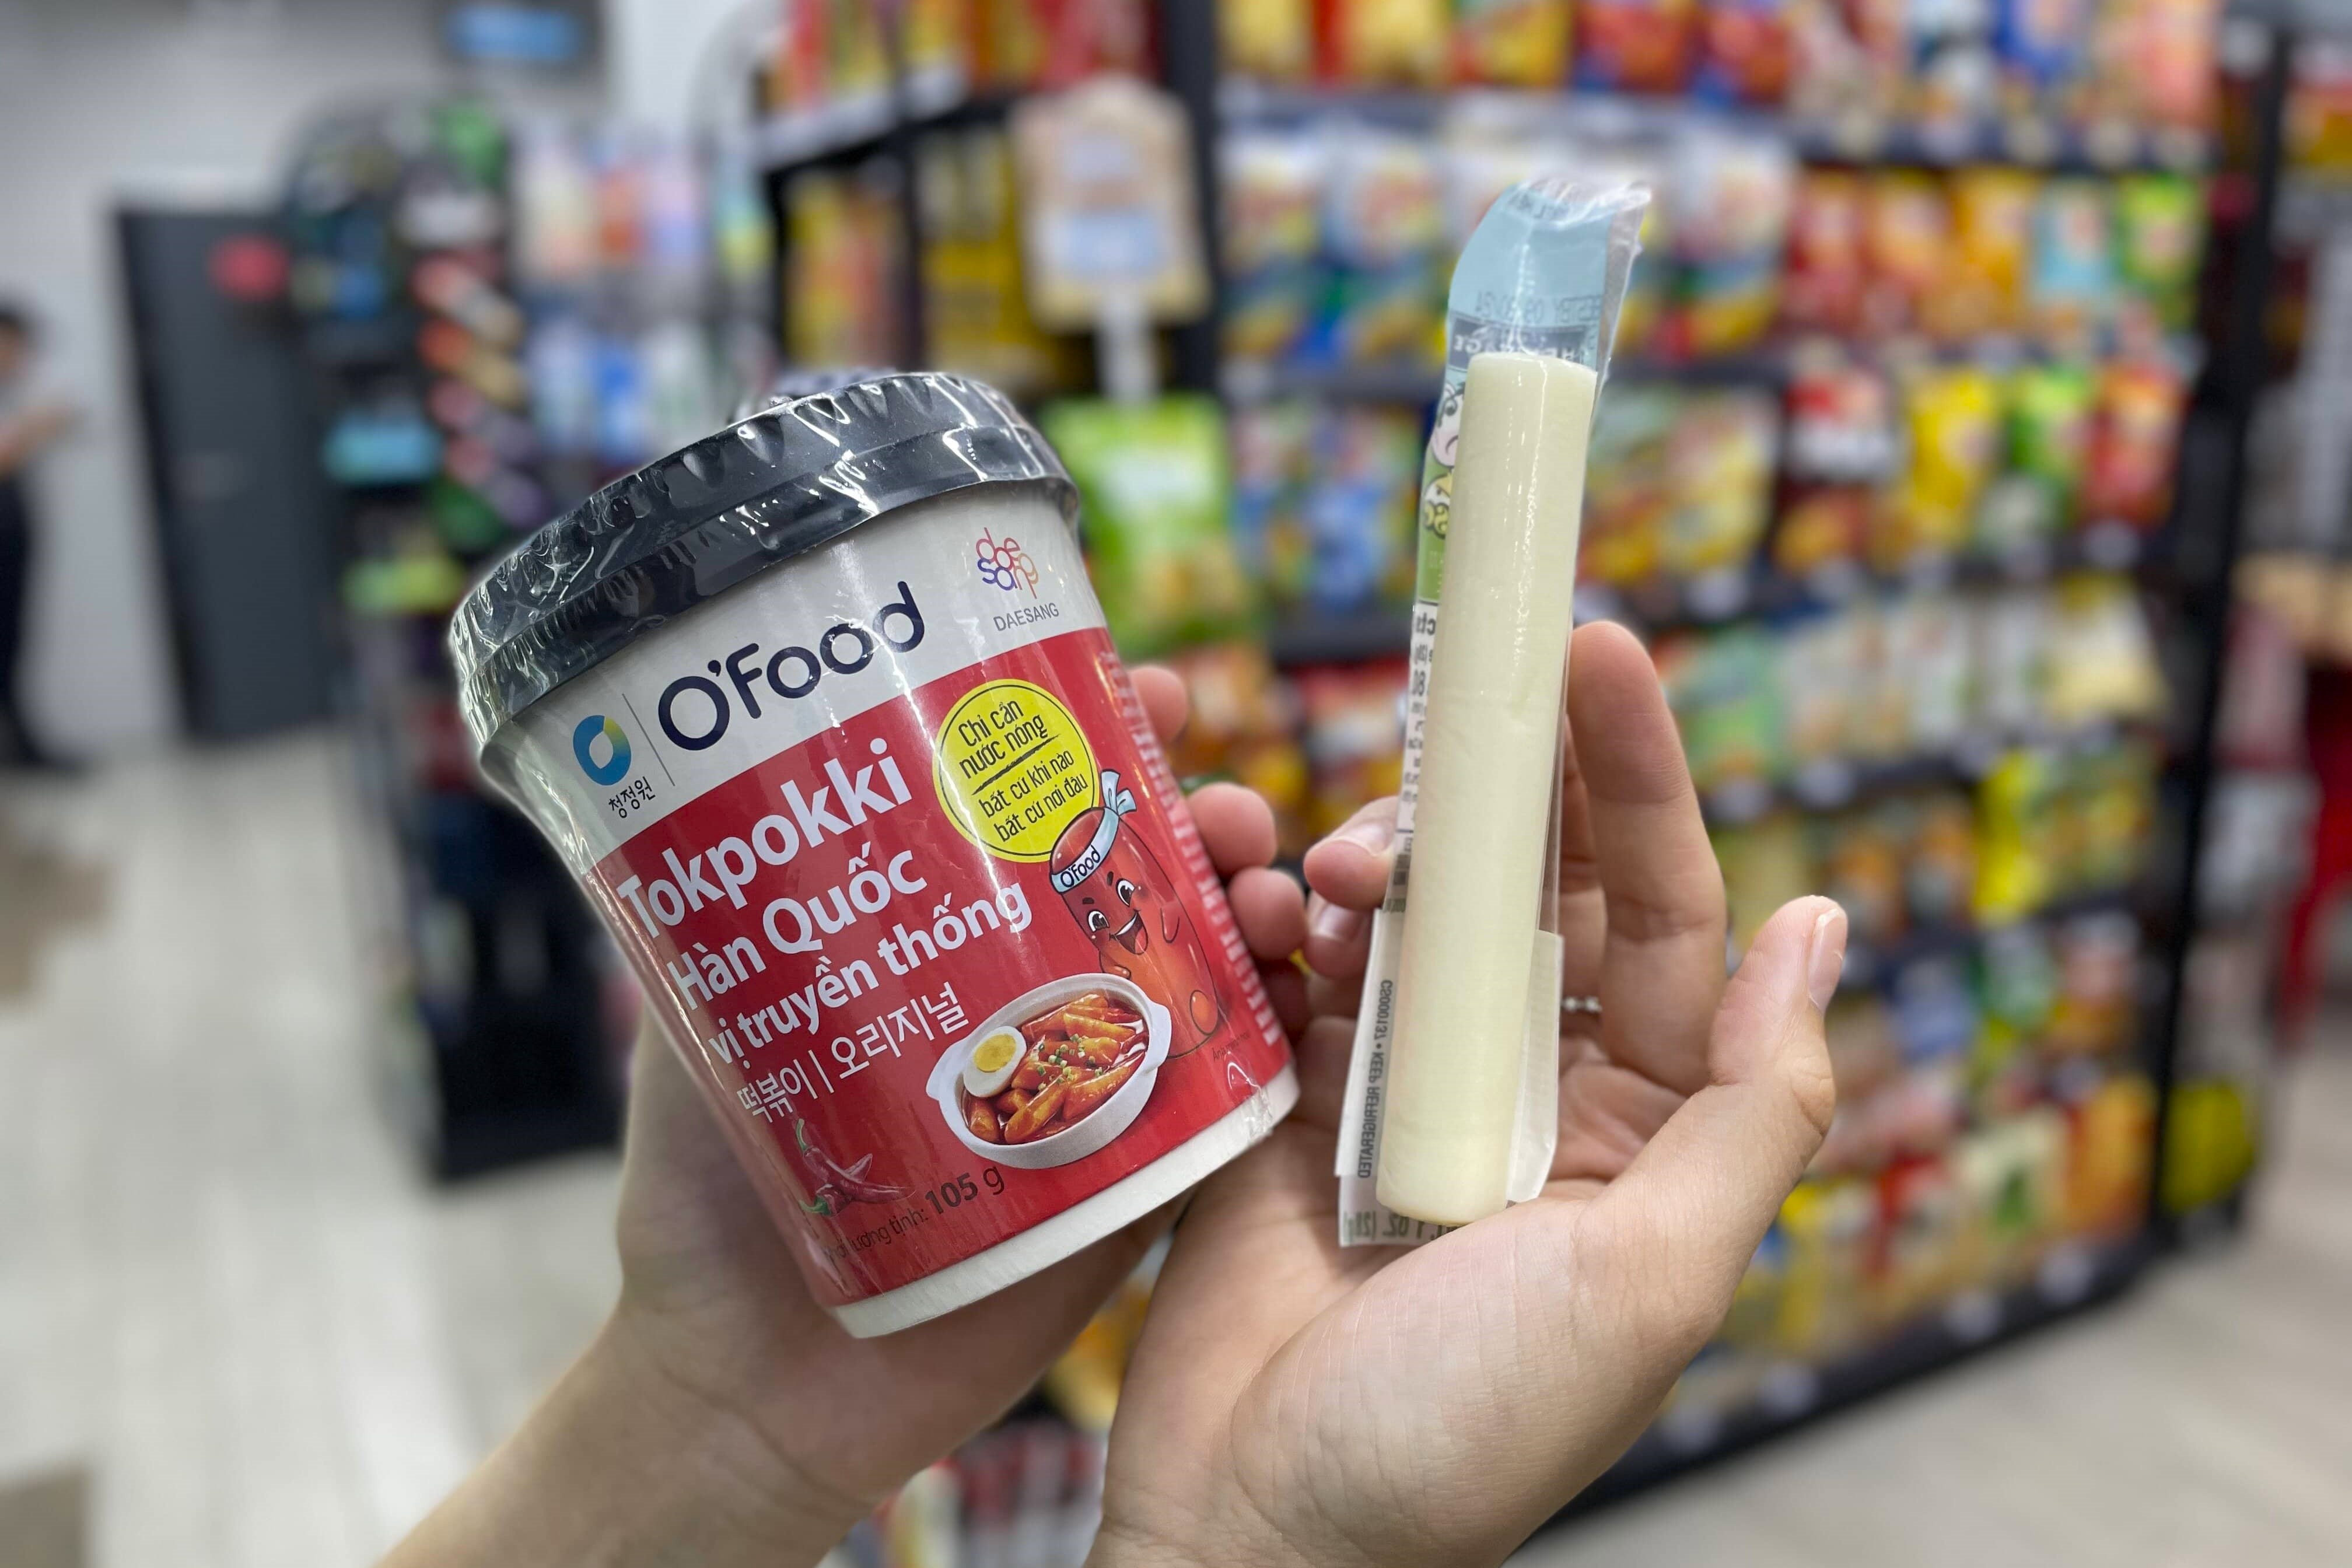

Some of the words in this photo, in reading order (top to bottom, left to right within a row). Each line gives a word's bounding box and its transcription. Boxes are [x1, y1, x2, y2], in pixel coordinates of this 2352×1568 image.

[993, 603, 1059, 632] DAESANG
[958, 713, 992, 747] Chỉ
[989, 699, 1024, 734] cần
[960, 740, 1006, 779] nước
[1004, 713, 1048, 752] nóng
[608, 775, 656, 819] 청정원
[979, 789, 1010, 819] bất
[1010, 773, 1031, 800] cứ
[1027, 760, 1051, 788] khi
[1050, 748, 1075, 776] nào
[993, 813, 1025, 843] bất
[1024, 797, 1044, 825] cứ
[1044, 786, 1065, 814] nơi
[1064, 772, 1089, 800] đâu
[617, 737, 912, 940] Tokpokki
[666, 935, 767, 1012] Hàn
[762, 841, 928, 954] Quốc
[709, 1017, 752, 1070] vị
[736, 956, 880, 1041] truyền
[877, 881, 1033, 977] thống
[736, 1059, 818, 1124] 떡볶이
[830, 981, 969, 1080] 오리지널
[924, 1172, 979, 1215] 105
[982, 1166, 1005, 1195] g
